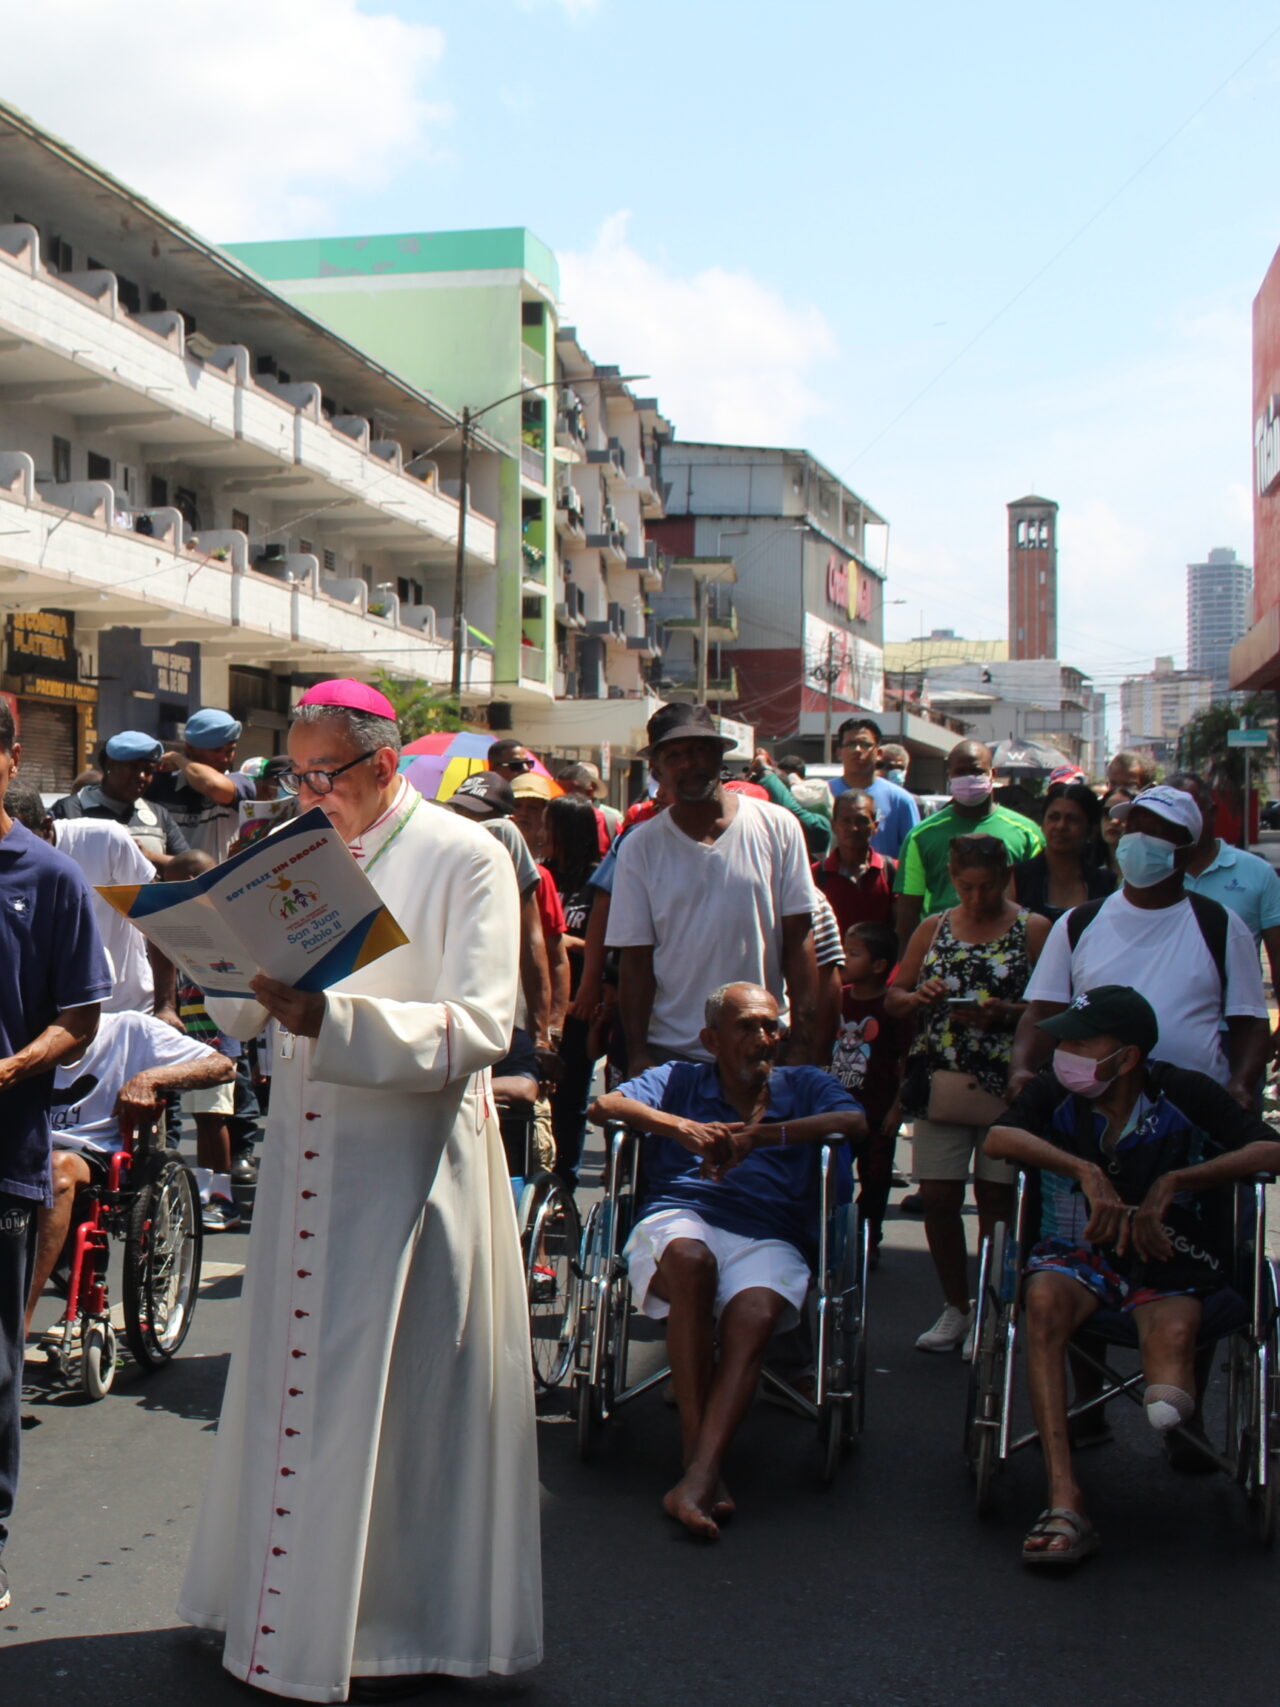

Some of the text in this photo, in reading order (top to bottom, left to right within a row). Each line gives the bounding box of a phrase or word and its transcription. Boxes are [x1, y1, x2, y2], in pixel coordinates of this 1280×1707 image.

[225, 887, 245, 902] SOY
[271, 861, 289, 875] SIN
[289, 837, 328, 864] DROGAS
[287, 927, 310, 944] San
[310, 909, 340, 930] Juan
[301, 927, 332, 950] Pablo
